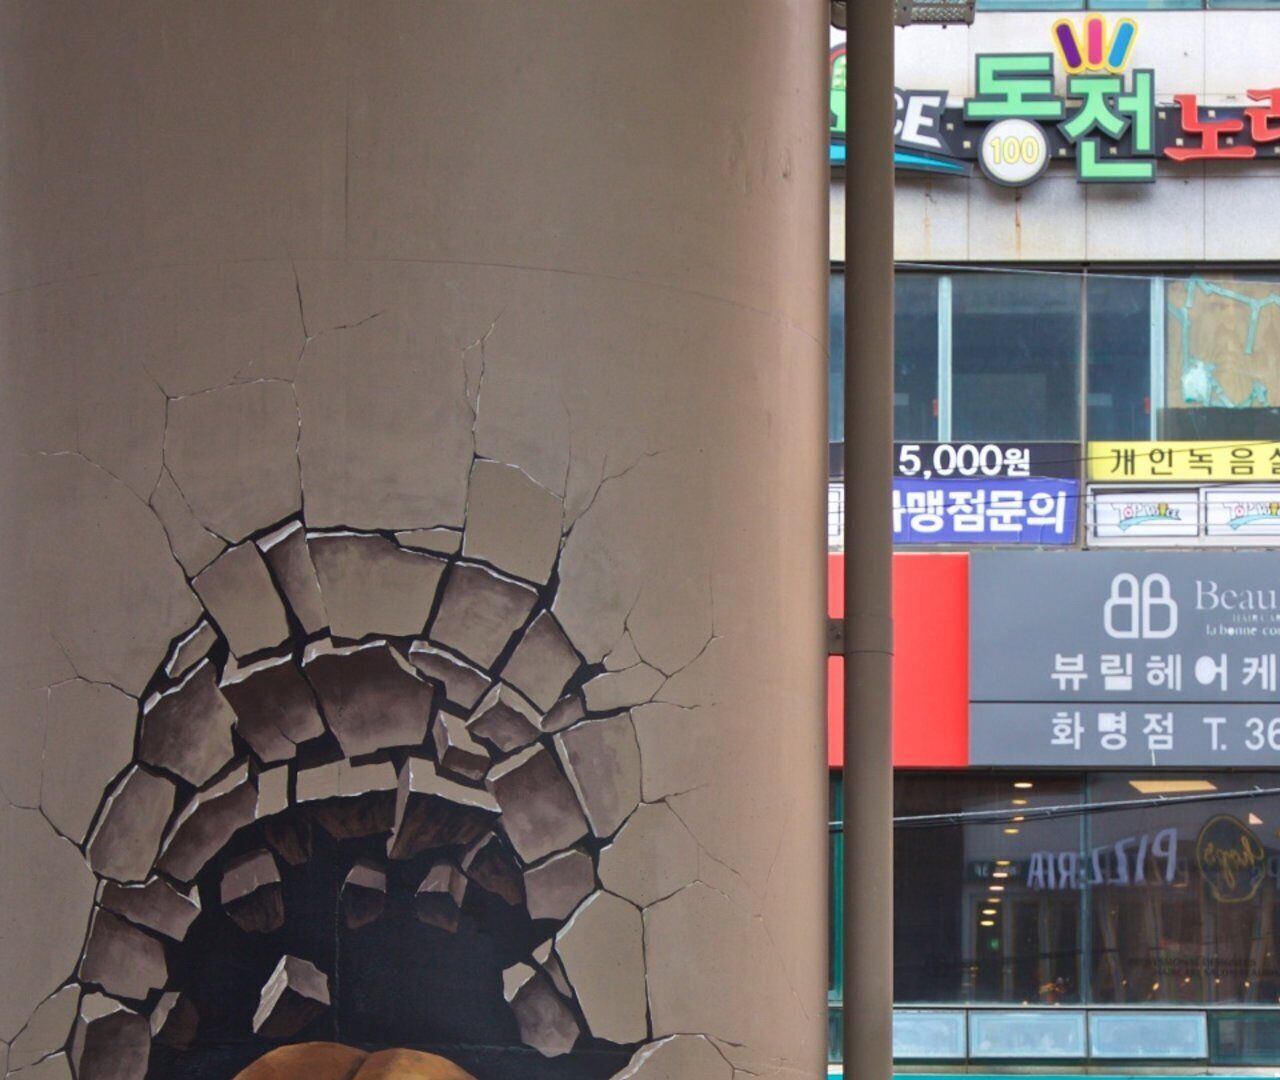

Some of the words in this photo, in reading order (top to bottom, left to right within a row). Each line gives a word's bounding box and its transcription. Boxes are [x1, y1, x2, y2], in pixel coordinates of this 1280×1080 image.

[989, 137, 1039, 164] 100
[898, 444, 1031, 481] 5,000원
[1220, 624, 1257, 637] bonne
[1051, 711, 1175, 751] 화명점
[1202, 716, 1228, 751] T.
